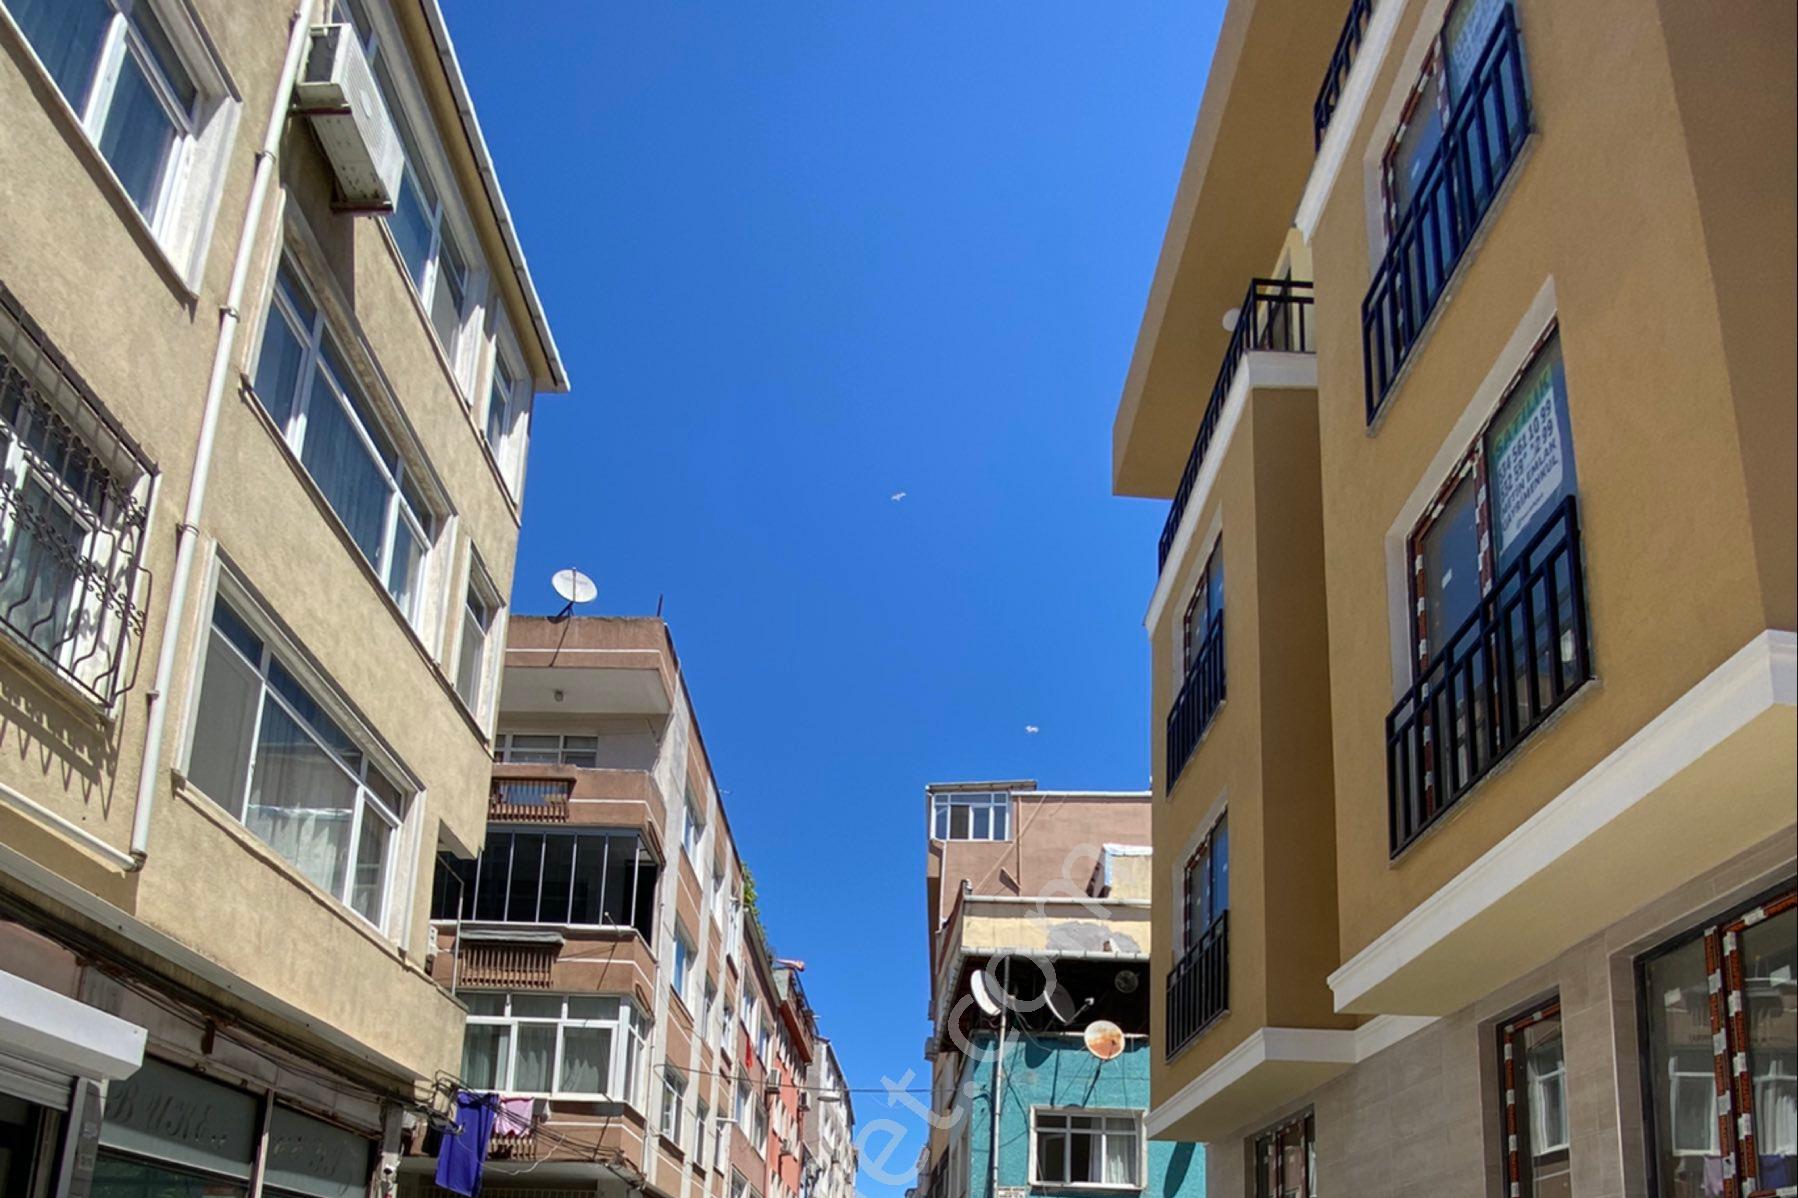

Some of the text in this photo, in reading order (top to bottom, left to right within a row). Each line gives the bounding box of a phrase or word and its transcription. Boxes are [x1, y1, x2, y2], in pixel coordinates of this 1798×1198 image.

[1527, 413, 1539, 443] 10
[1539, 396, 1551, 426] 99
[1541, 415, 1553, 446] 99
[1526, 436, 1556, 484] EMLAK
